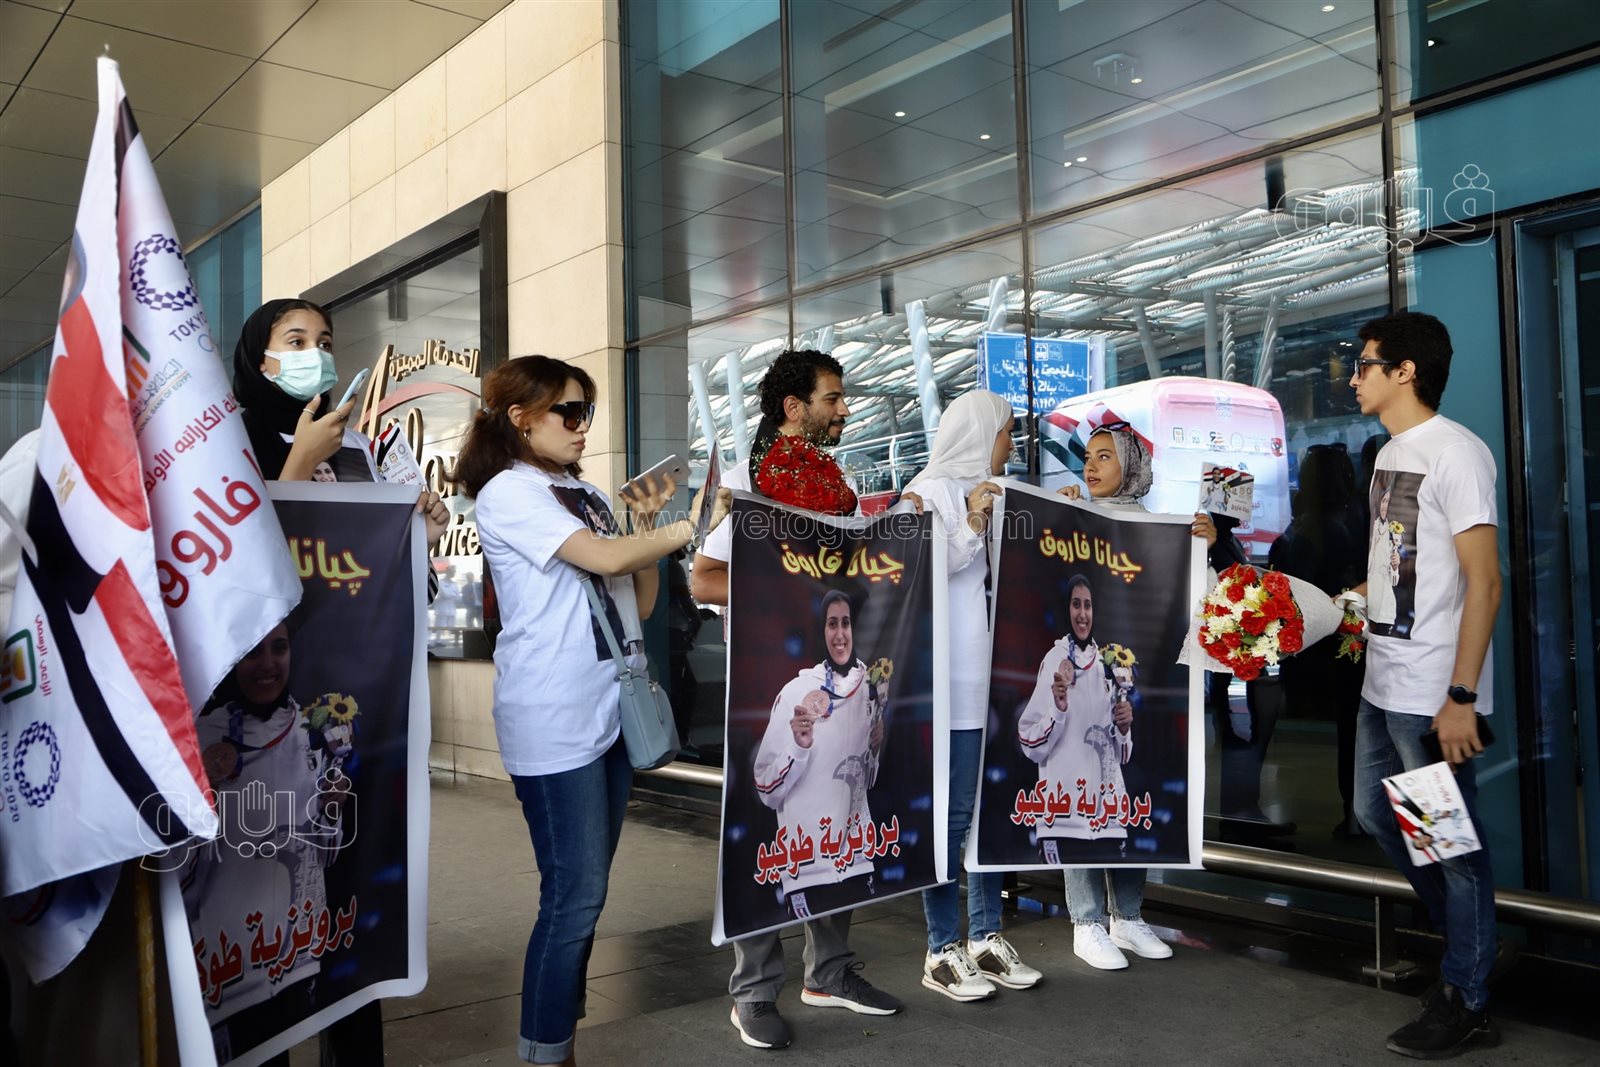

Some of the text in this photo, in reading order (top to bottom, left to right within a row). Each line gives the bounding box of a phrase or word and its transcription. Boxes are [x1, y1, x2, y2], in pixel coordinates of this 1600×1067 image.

[389, 338, 480, 381] الخدمة المميزة
[174, 403, 227, 454] الكاراتيه
[1, 732, 20, 823] TOKYO 2020
[1010, 778, 1153, 831] برونزية طوكيو
[754, 814, 901, 885] برونزية طوكيو
[250, 895, 357, 985] برونزية
